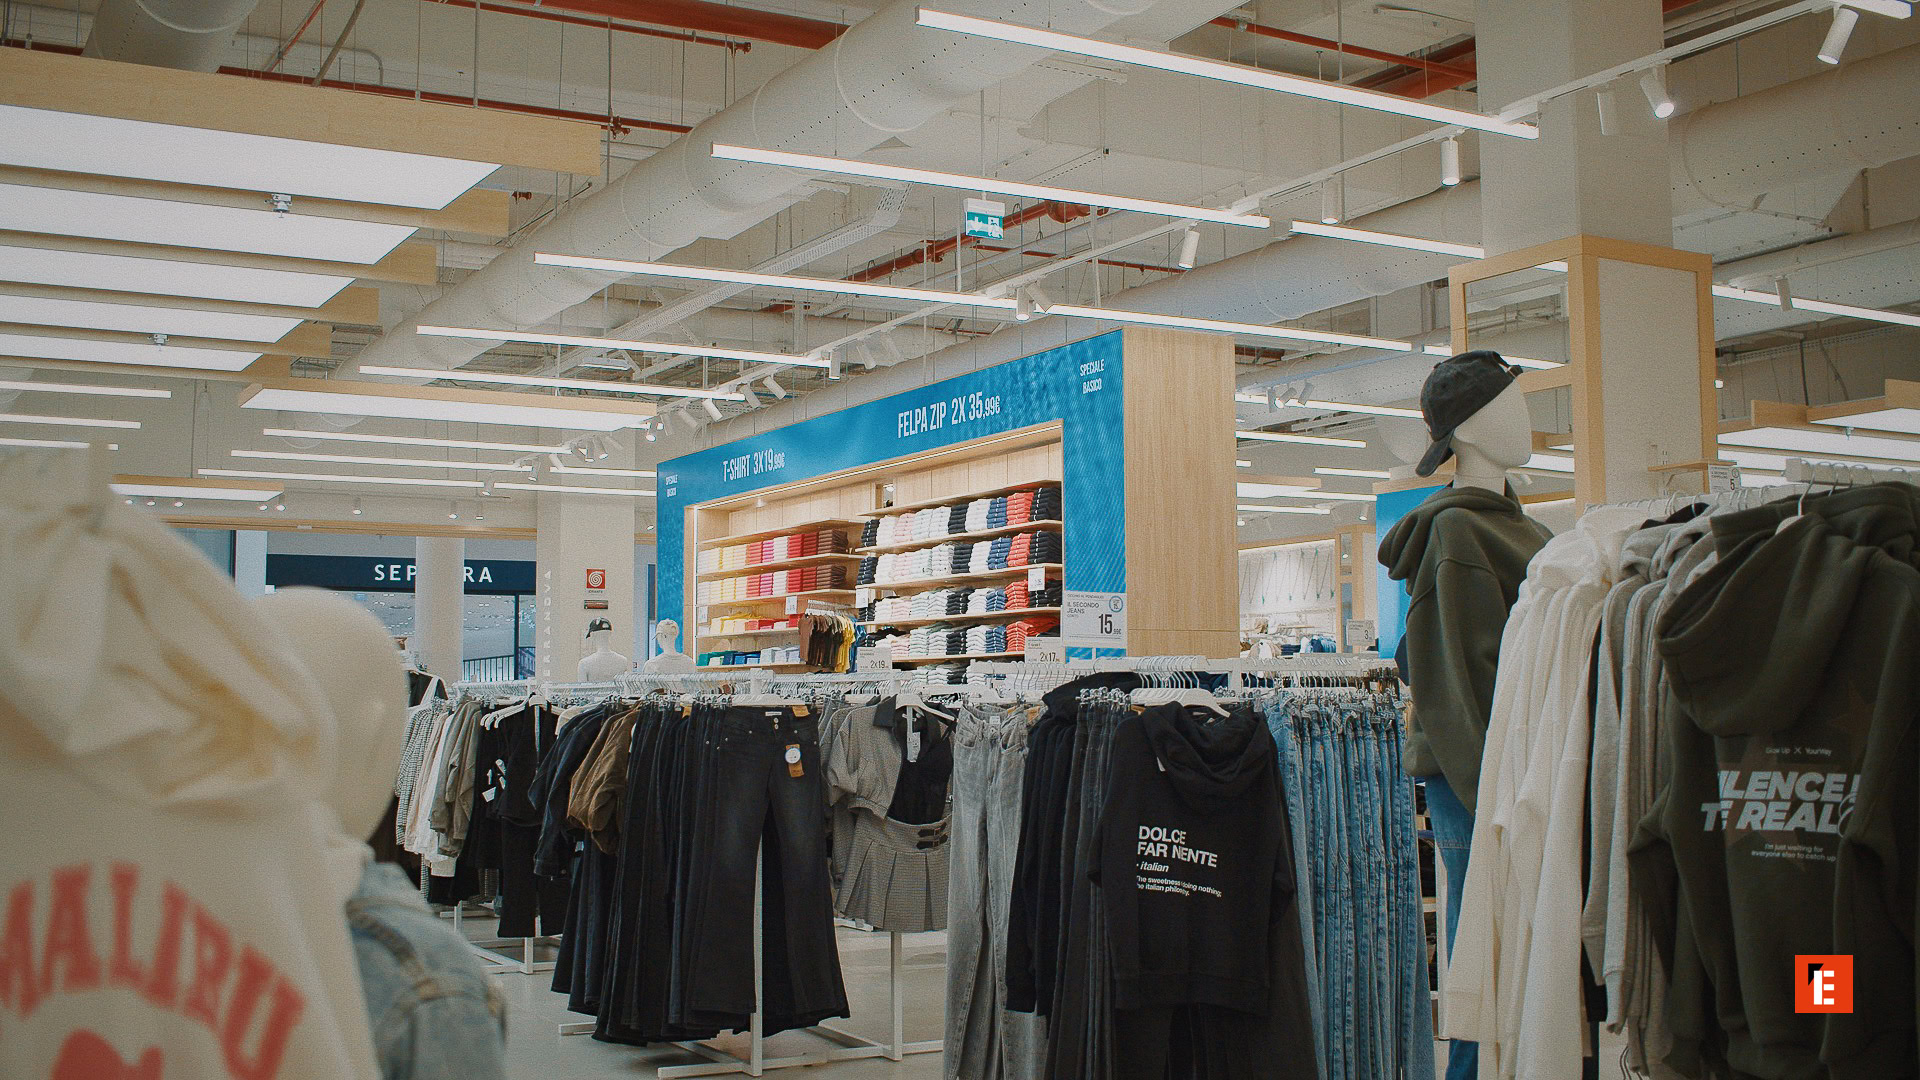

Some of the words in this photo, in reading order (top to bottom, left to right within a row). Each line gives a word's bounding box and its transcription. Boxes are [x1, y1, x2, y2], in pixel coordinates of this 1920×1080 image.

[1080, 358, 1105, 377] SPECIALE
[897, 406, 929, 438] FELPA
[929, 401, 947, 431] ZIP
[722, 454, 751, 482] T-SHIRT
[374, 564, 493, 583] SEPRA
[1073, 601, 1100, 609] SECONDO
[542, 569, 552, 677] ERRANOVA
[1717, 770, 1848, 802] ILENCE
[1735, 801, 1839, 834] REAL
[1138, 825, 1187, 845] DOLCE
[1137, 841, 1168, 858] FAR
[1751, 850, 1781, 858] everyone
[1781, 850, 1796, 858] else
[1797, 851, 1805, 859] to
[1805, 852, 1826, 861] catch
[1826, 854, 1837, 862] up
[1787, 844, 1813, 853] waiting
[1813, 845, 1824, 853] for
[1140, 861, 1169, 873] italian
[1145, 882, 1165, 891] italian
[1147, 877, 1181, 886] sweetness
